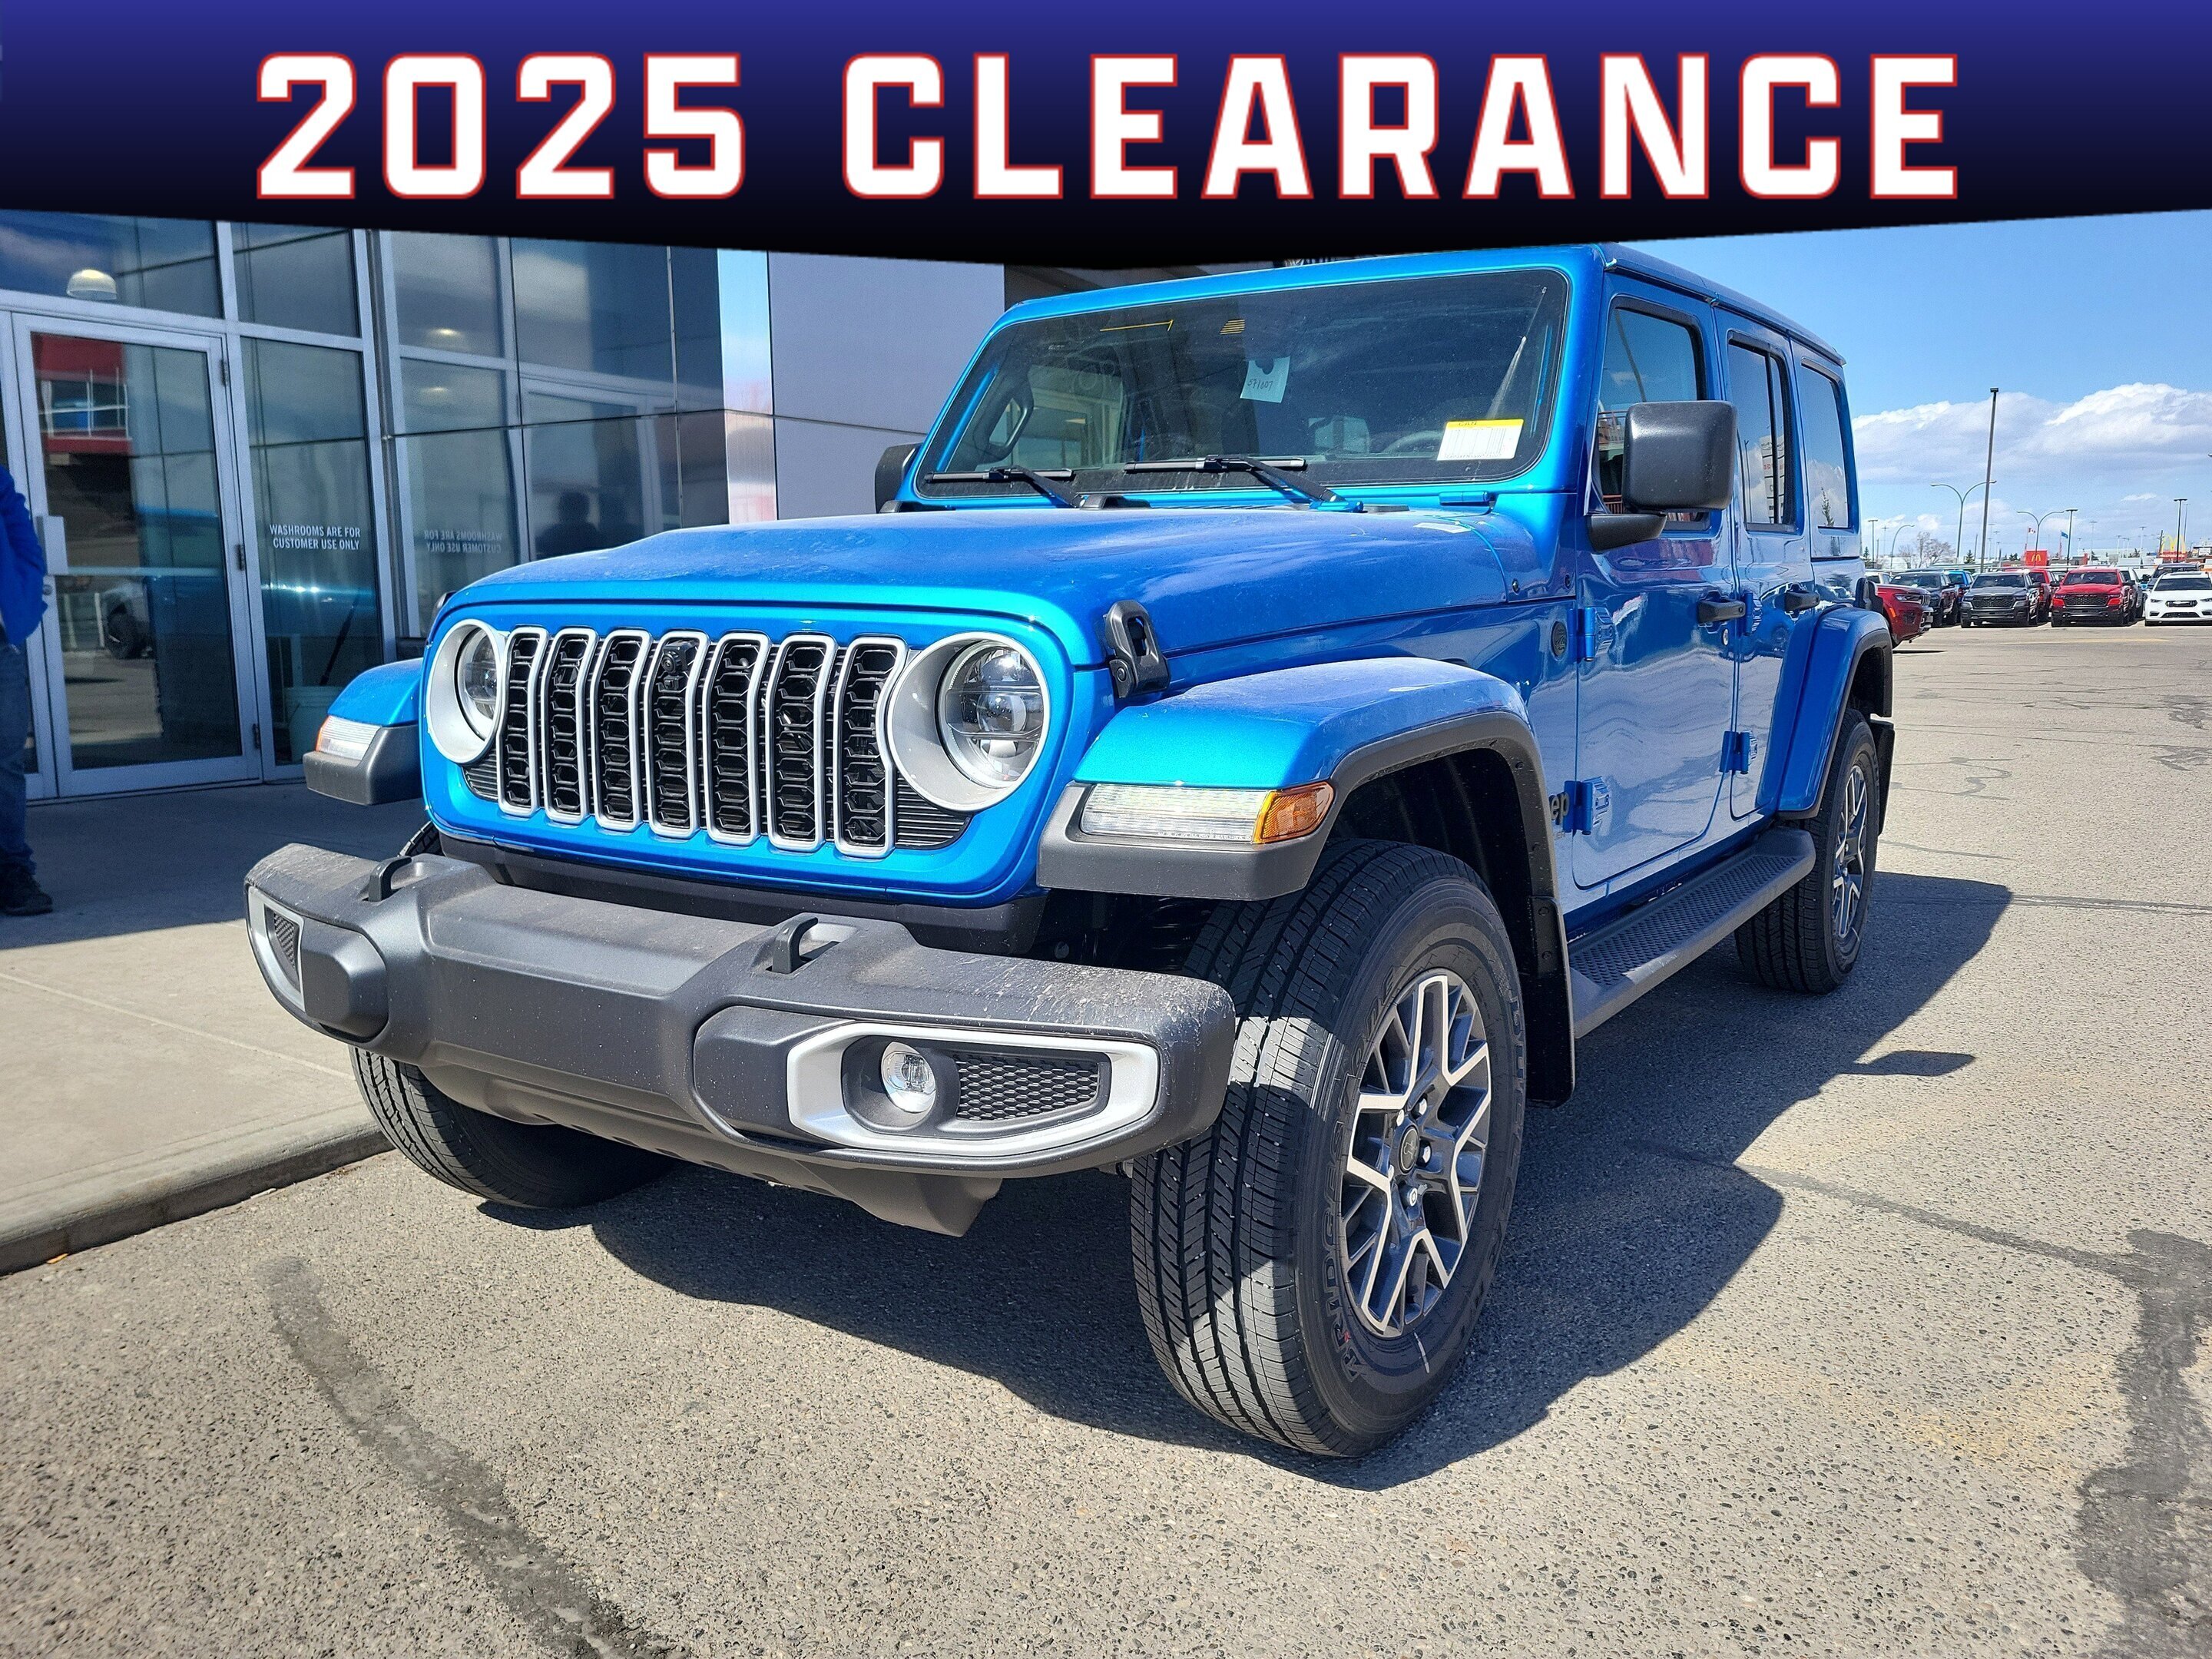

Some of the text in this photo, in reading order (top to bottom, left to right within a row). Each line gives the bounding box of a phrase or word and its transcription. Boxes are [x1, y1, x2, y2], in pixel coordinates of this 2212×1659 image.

[270, 524, 361, 538] WASHROOMS ARE FOR
[273, 538, 359, 550] CUSTOMER USE ONLY
